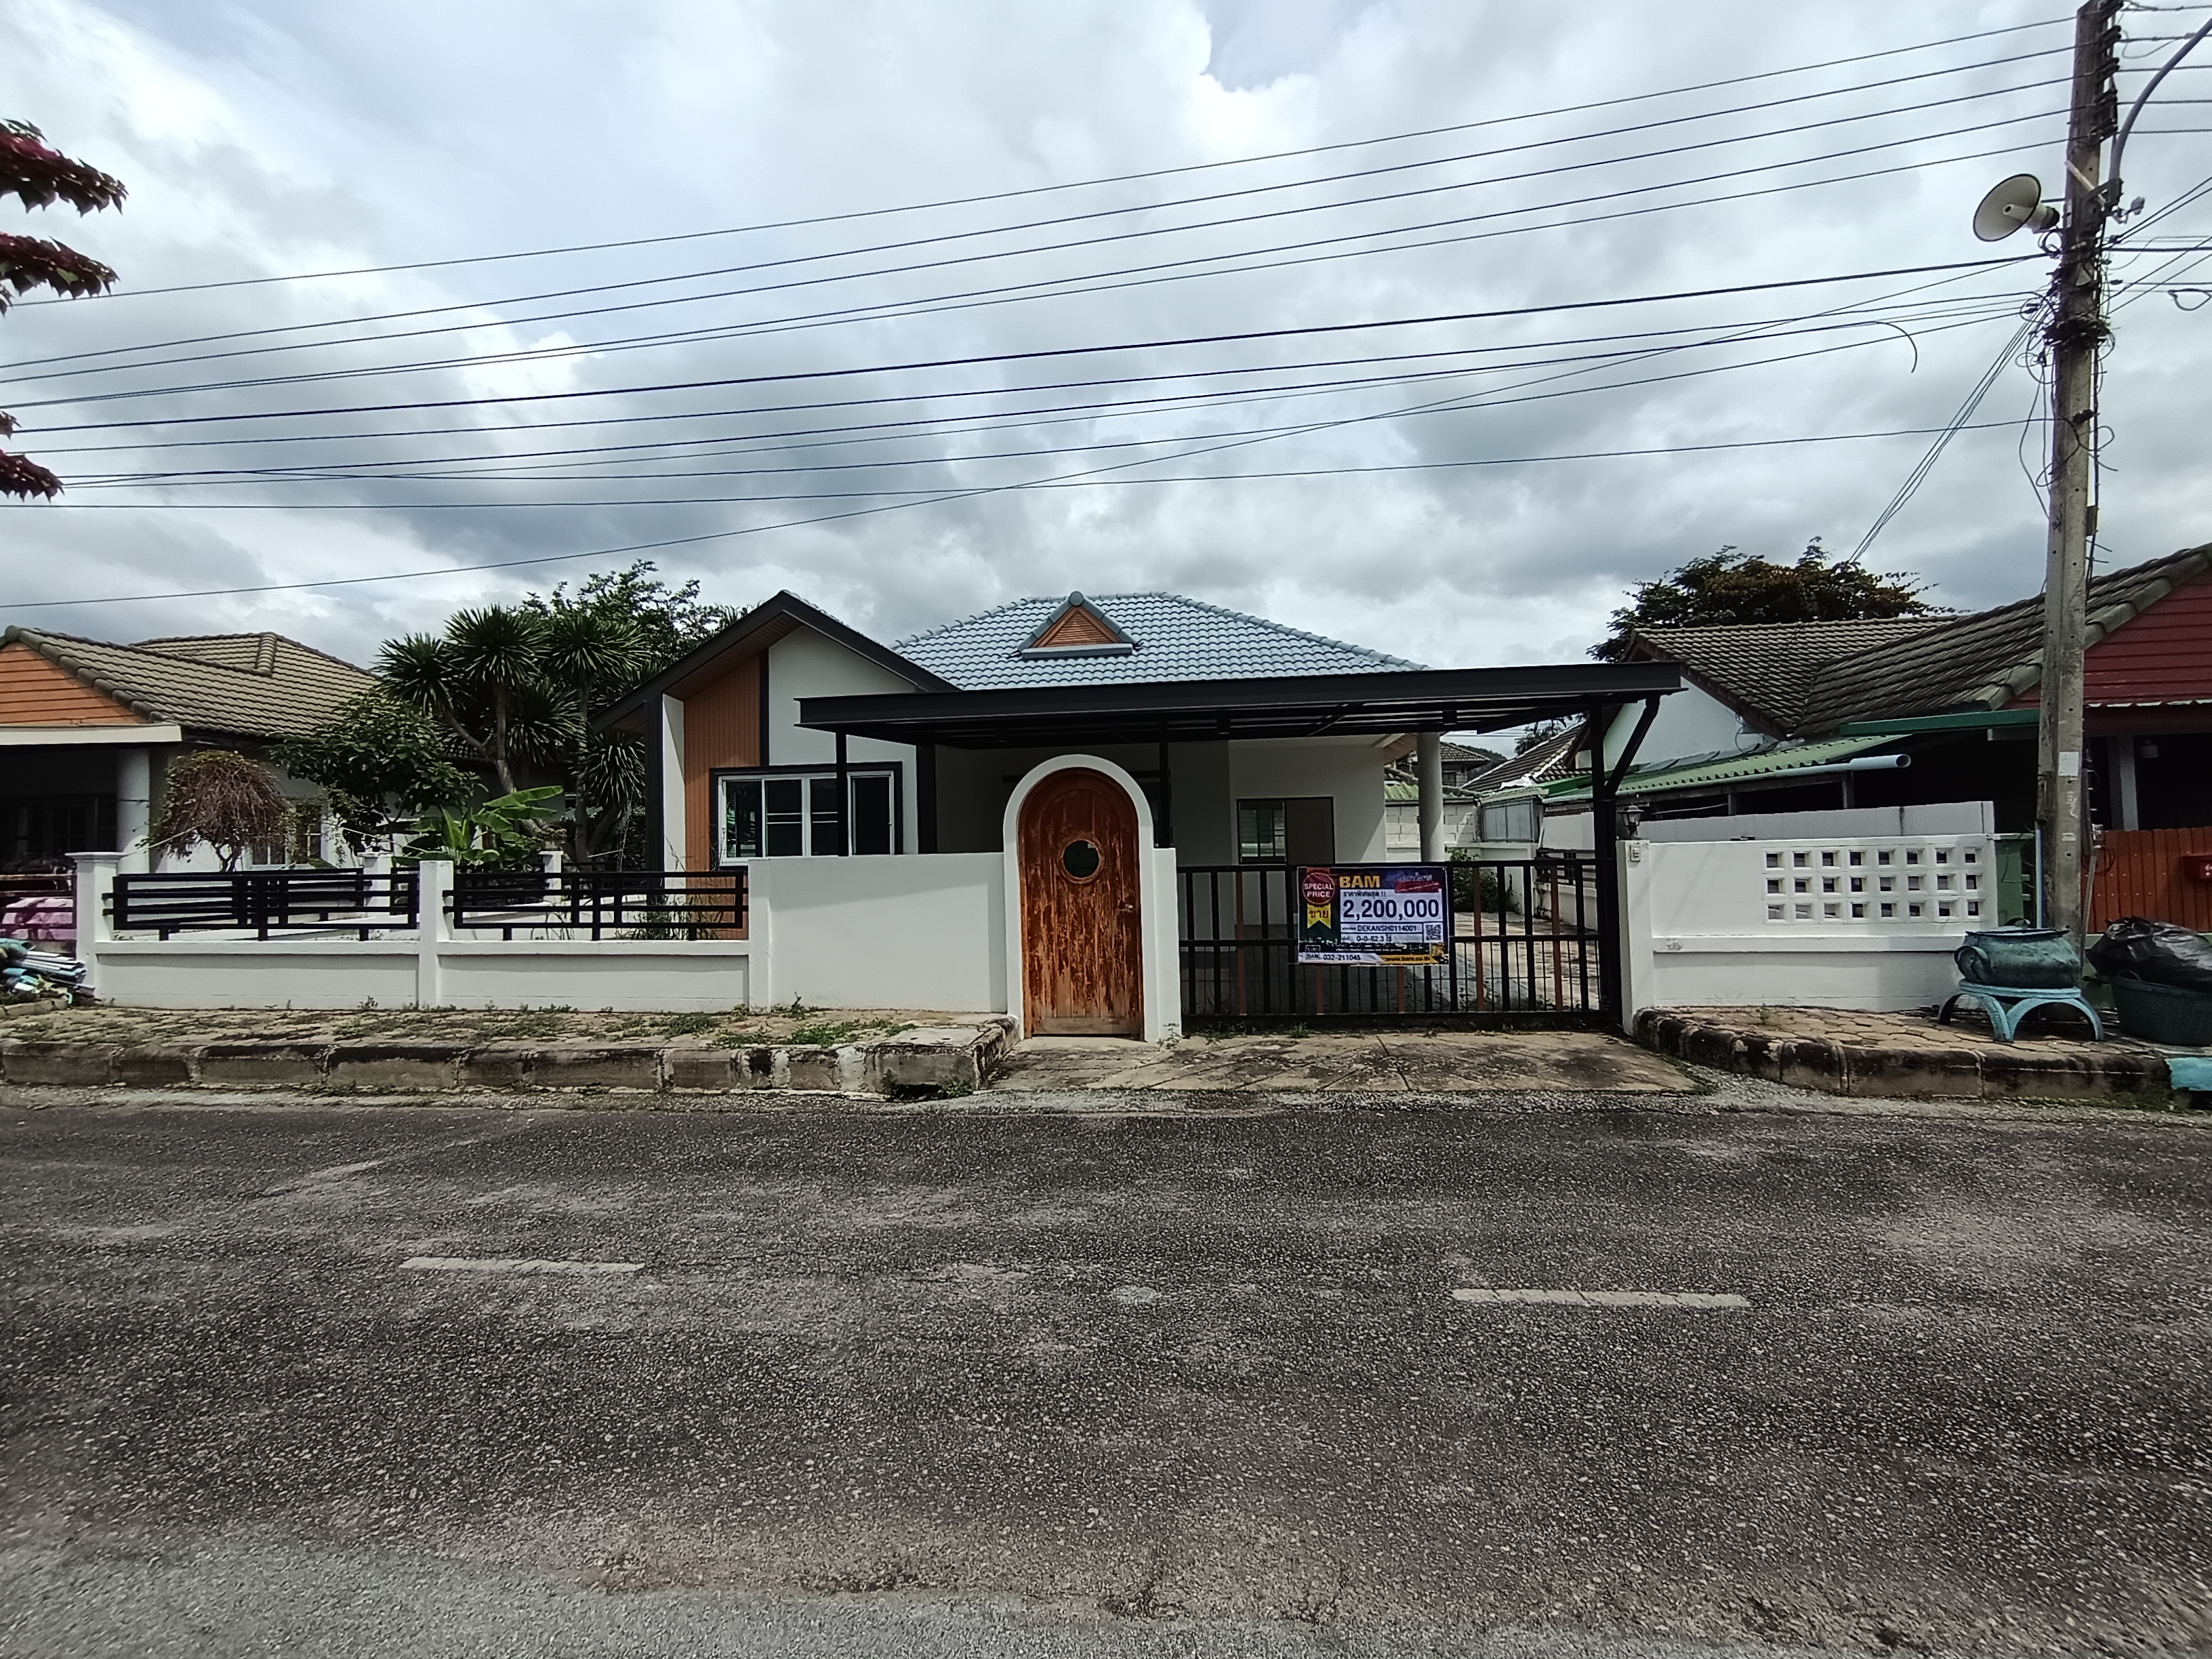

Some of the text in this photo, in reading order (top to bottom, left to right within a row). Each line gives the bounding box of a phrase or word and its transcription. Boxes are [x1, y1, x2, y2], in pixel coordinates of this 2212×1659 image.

[1339, 876, 1380, 888] BAM
[1309, 909, 1329, 918] ขาย
[1343, 899, 1439, 920] 2,200,000
